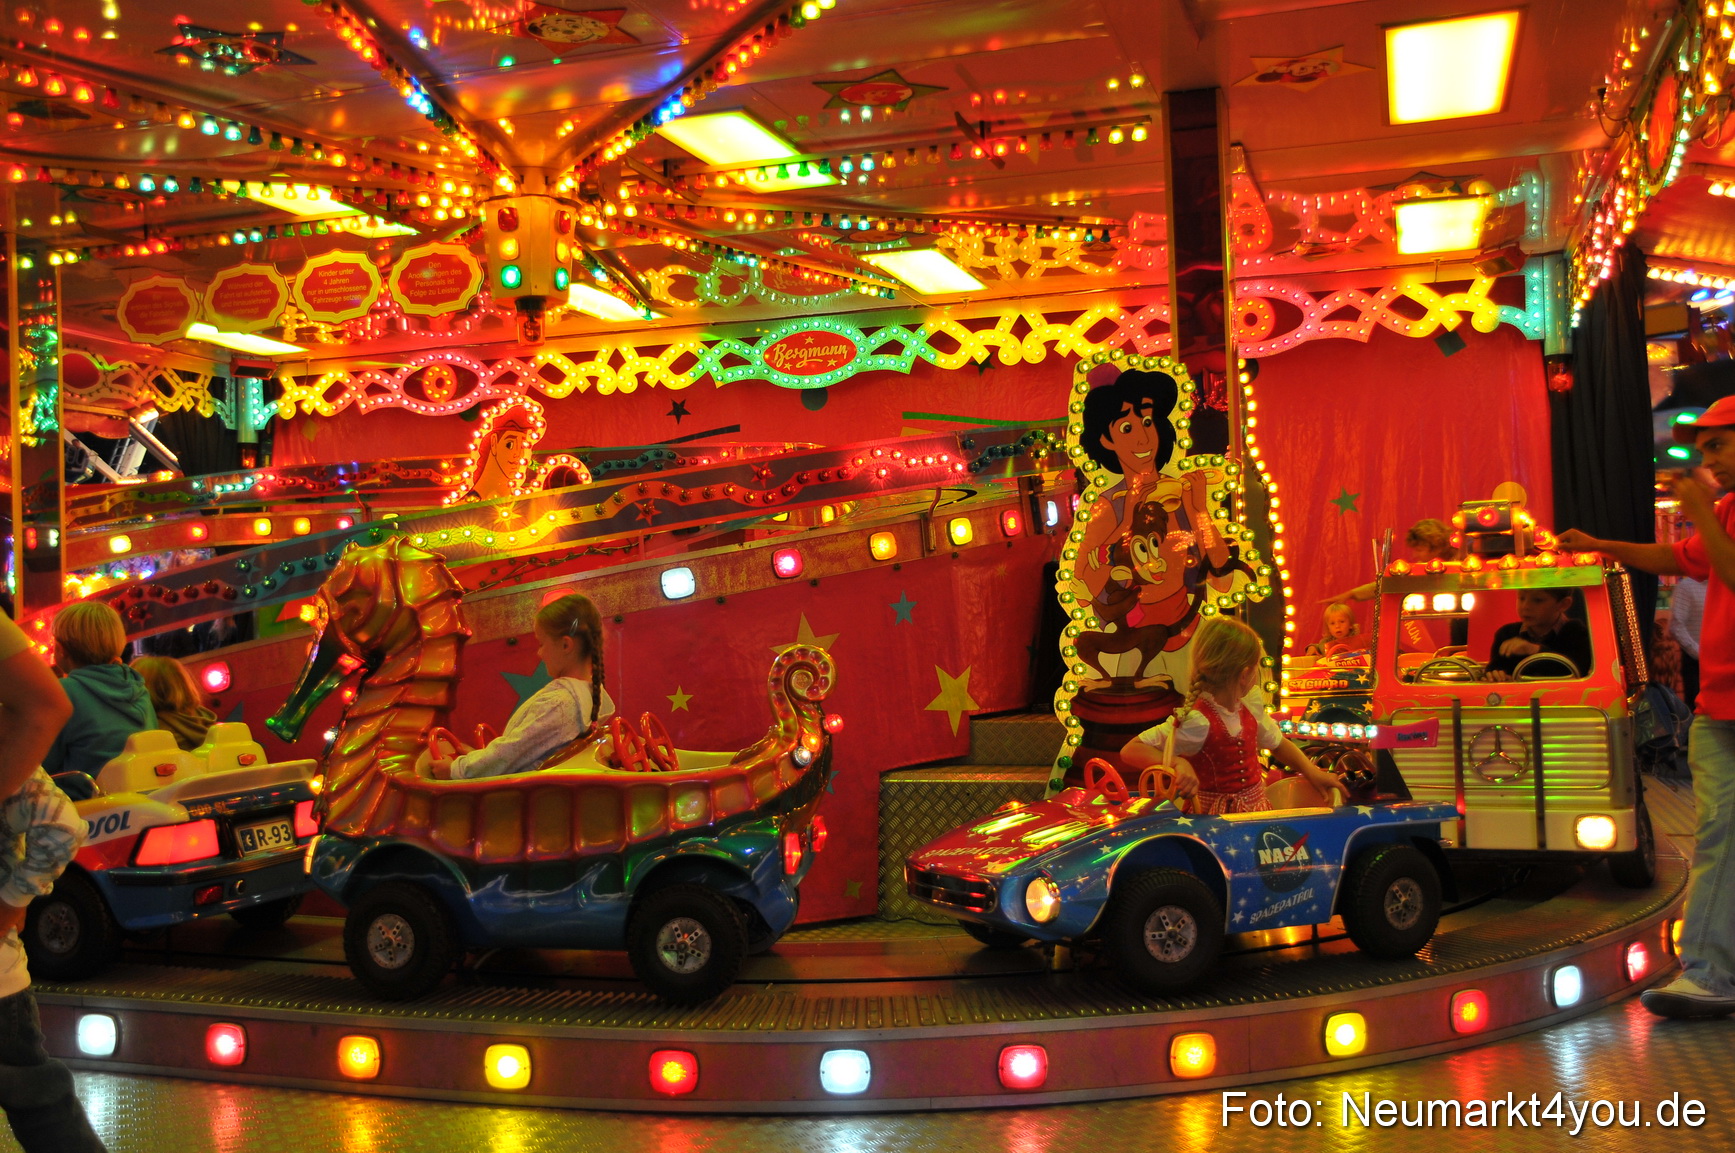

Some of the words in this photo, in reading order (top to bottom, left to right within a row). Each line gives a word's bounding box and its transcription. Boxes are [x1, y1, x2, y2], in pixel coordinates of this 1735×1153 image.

[428, 261, 442, 269] Den
[318, 270, 338, 278] Kinder
[338, 268, 355, 276] unter
[415, 279, 446, 288] Personals
[324, 285, 367, 294] umschlossene
[409, 289, 428, 298] Folge
[437, 287, 461, 295] Leisten
[312, 296, 342, 304] Fahrzeuge
[773, 343, 848, 368] Bergmann
[1305, 679, 1349, 690] GUARD
[256, 824, 292, 847] R-93
[1258, 845, 1309, 865] NASA
[1249, 887, 1315, 925] SPACEPATROL
